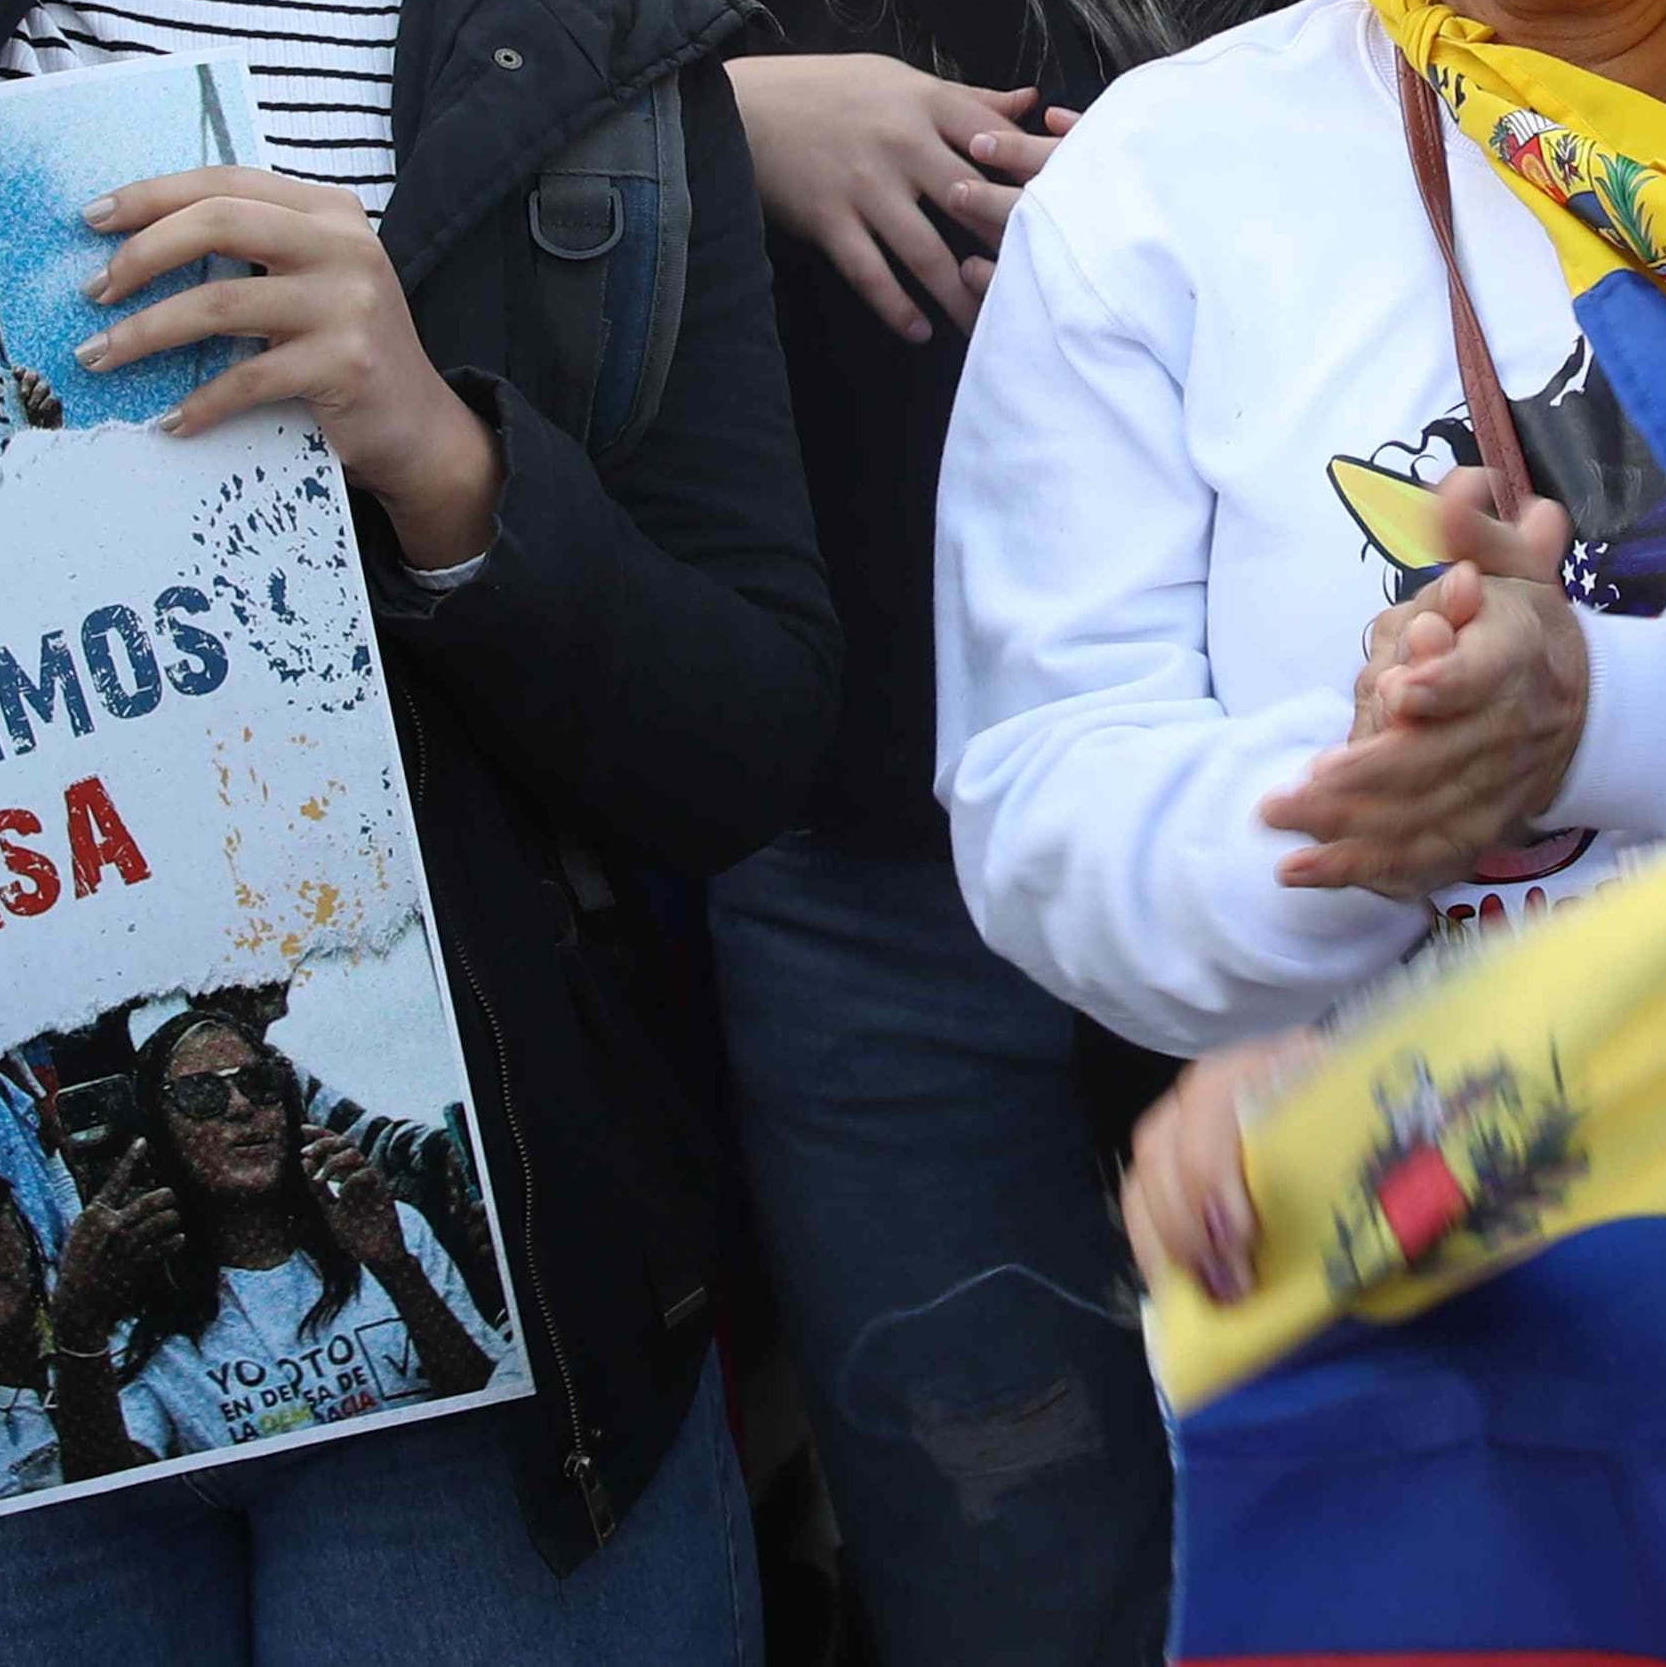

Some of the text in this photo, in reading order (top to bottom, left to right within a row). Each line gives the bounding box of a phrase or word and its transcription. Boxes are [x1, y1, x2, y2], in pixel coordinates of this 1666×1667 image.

[206, 1334, 355, 1396] YO OTO
[219, 1396, 255, 1423] EN
[336, 1365, 369, 1392] DE
[228, 1420, 261, 1444] LA
